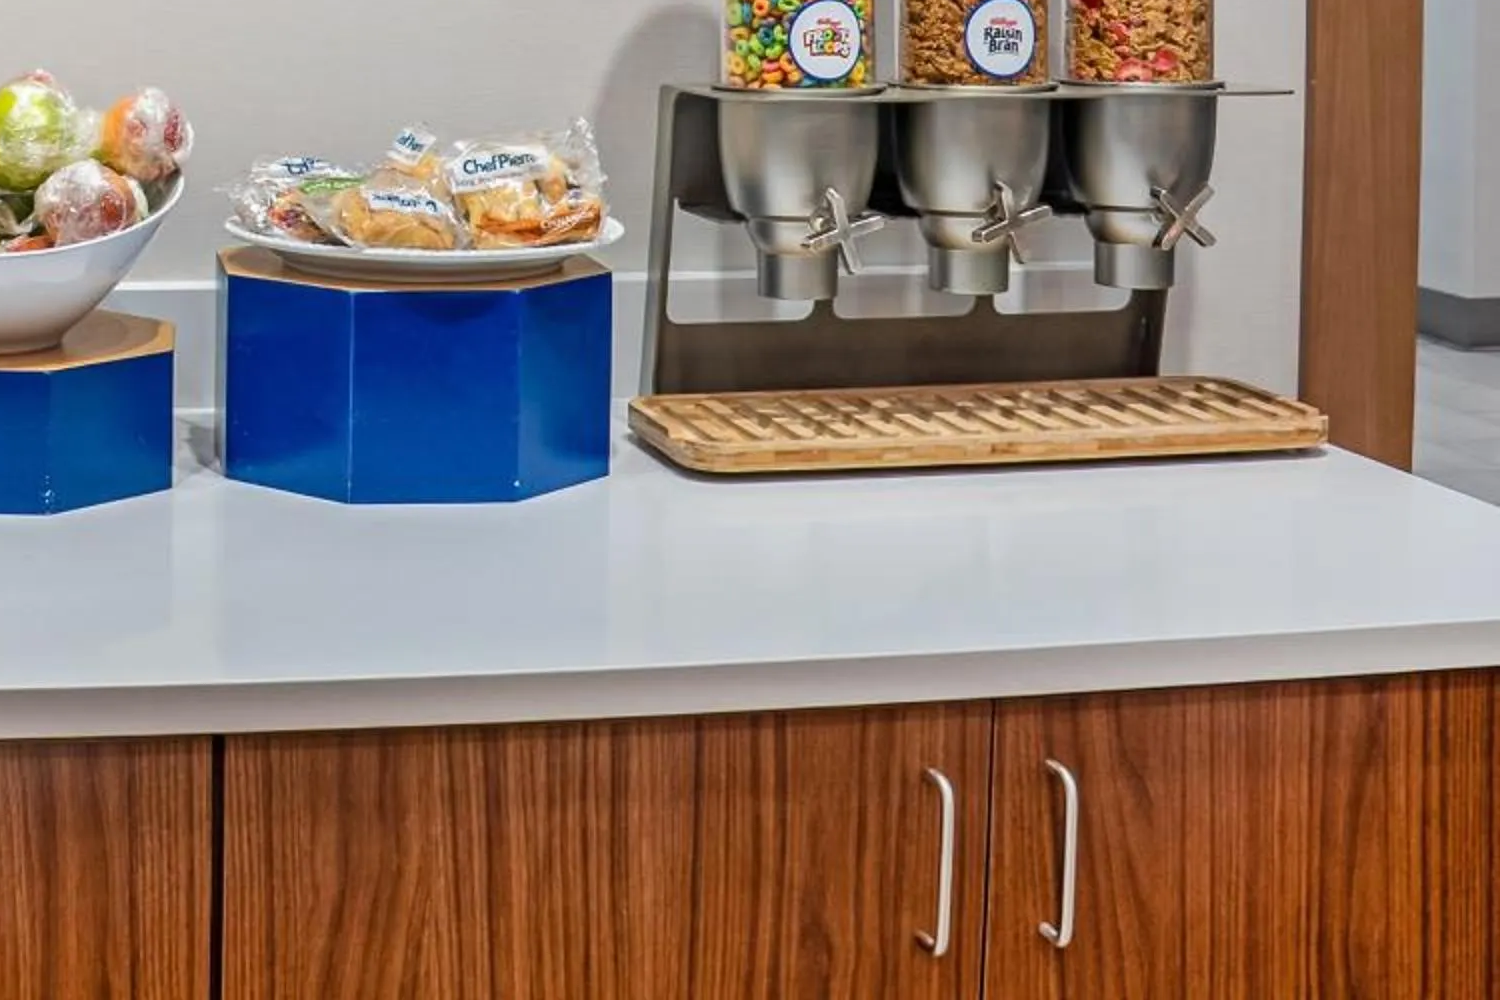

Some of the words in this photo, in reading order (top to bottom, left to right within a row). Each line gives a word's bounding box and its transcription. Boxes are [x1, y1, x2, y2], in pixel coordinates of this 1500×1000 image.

[983, 26, 1023, 42] Raisin
[988, 39, 1020, 53] Bran
[463, 155, 499, 175] Chef
